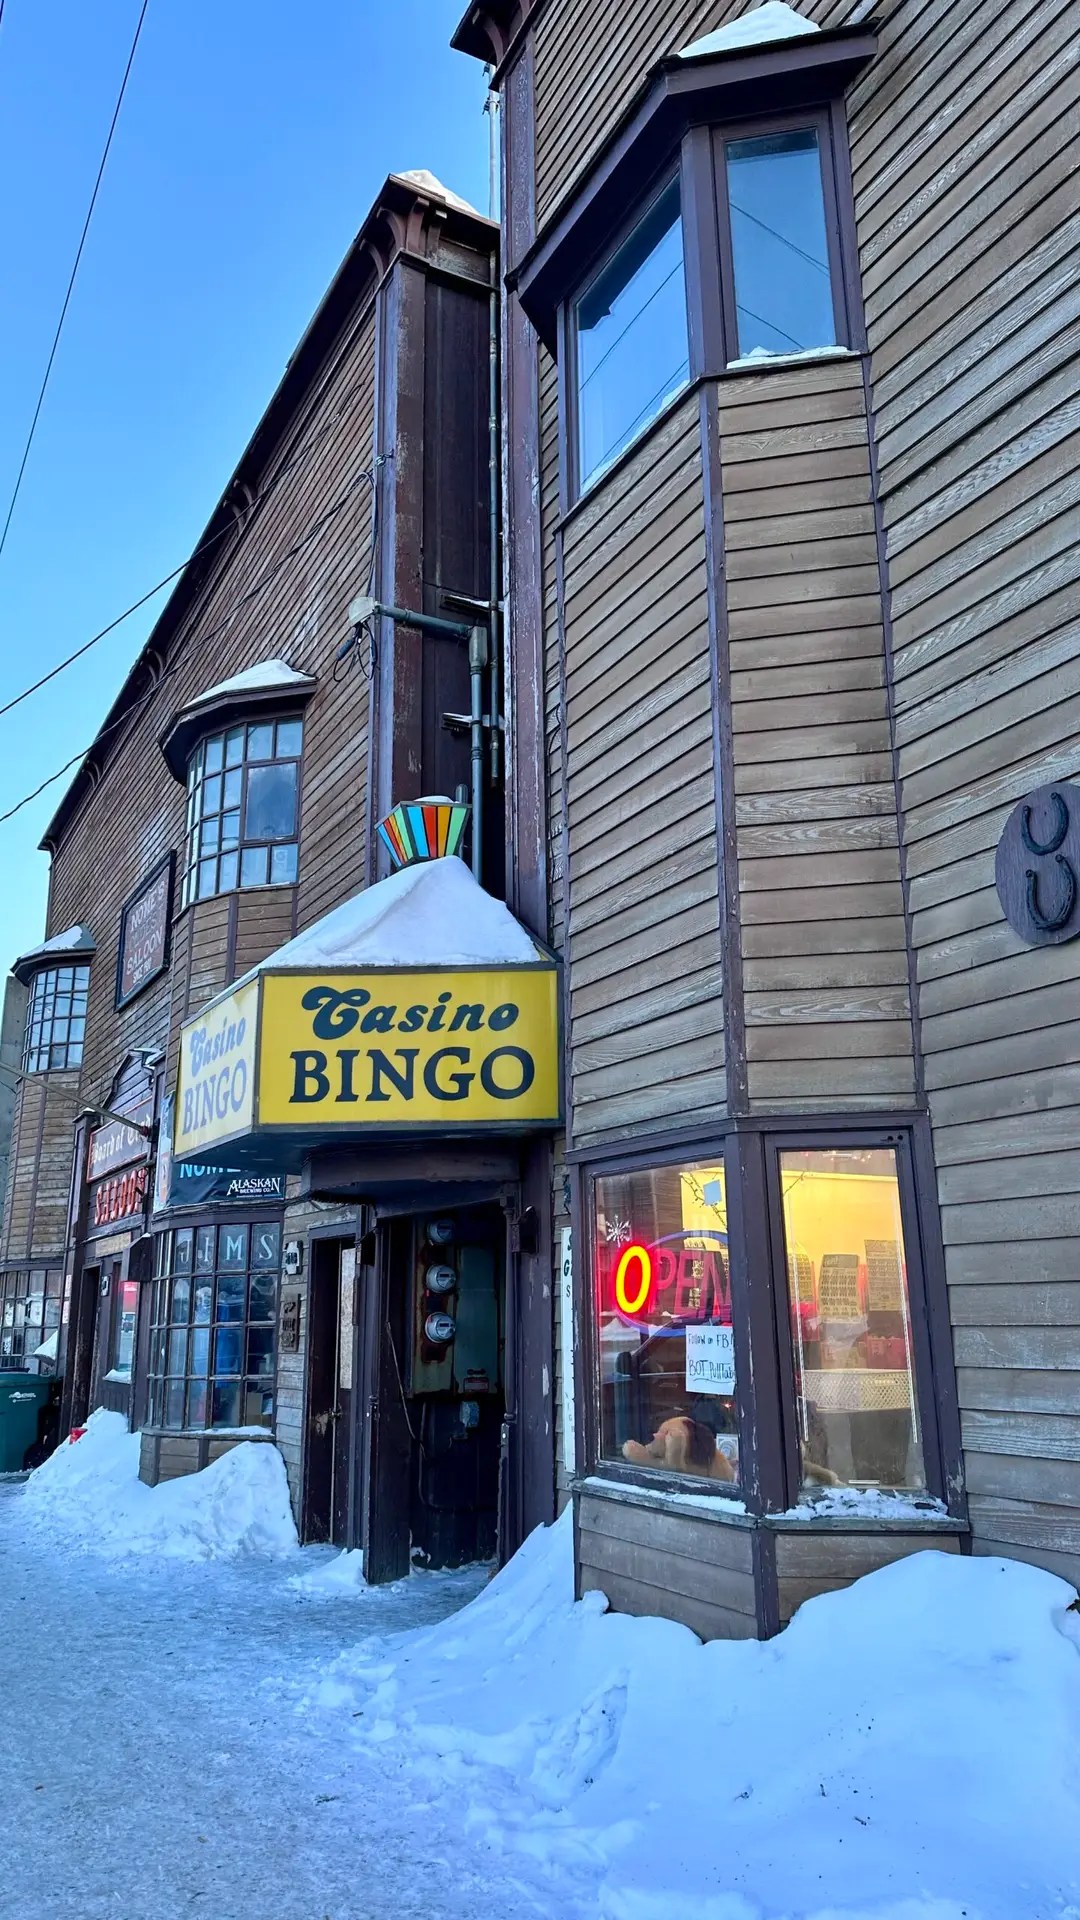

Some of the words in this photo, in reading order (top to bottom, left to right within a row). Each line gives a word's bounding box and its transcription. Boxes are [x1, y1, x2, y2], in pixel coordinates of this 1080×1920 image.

[126, 926, 163, 975] SALOON
[301, 985, 520, 1040] Casino
[189, 1016, 247, 1078] Casino
[288, 1045, 536, 1104] BINGO
[181, 1058, 248, 1136] BINGO
[226, 1177, 281, 1196] ALASKAN
[615, 1245, 732, 1321] OPEN
